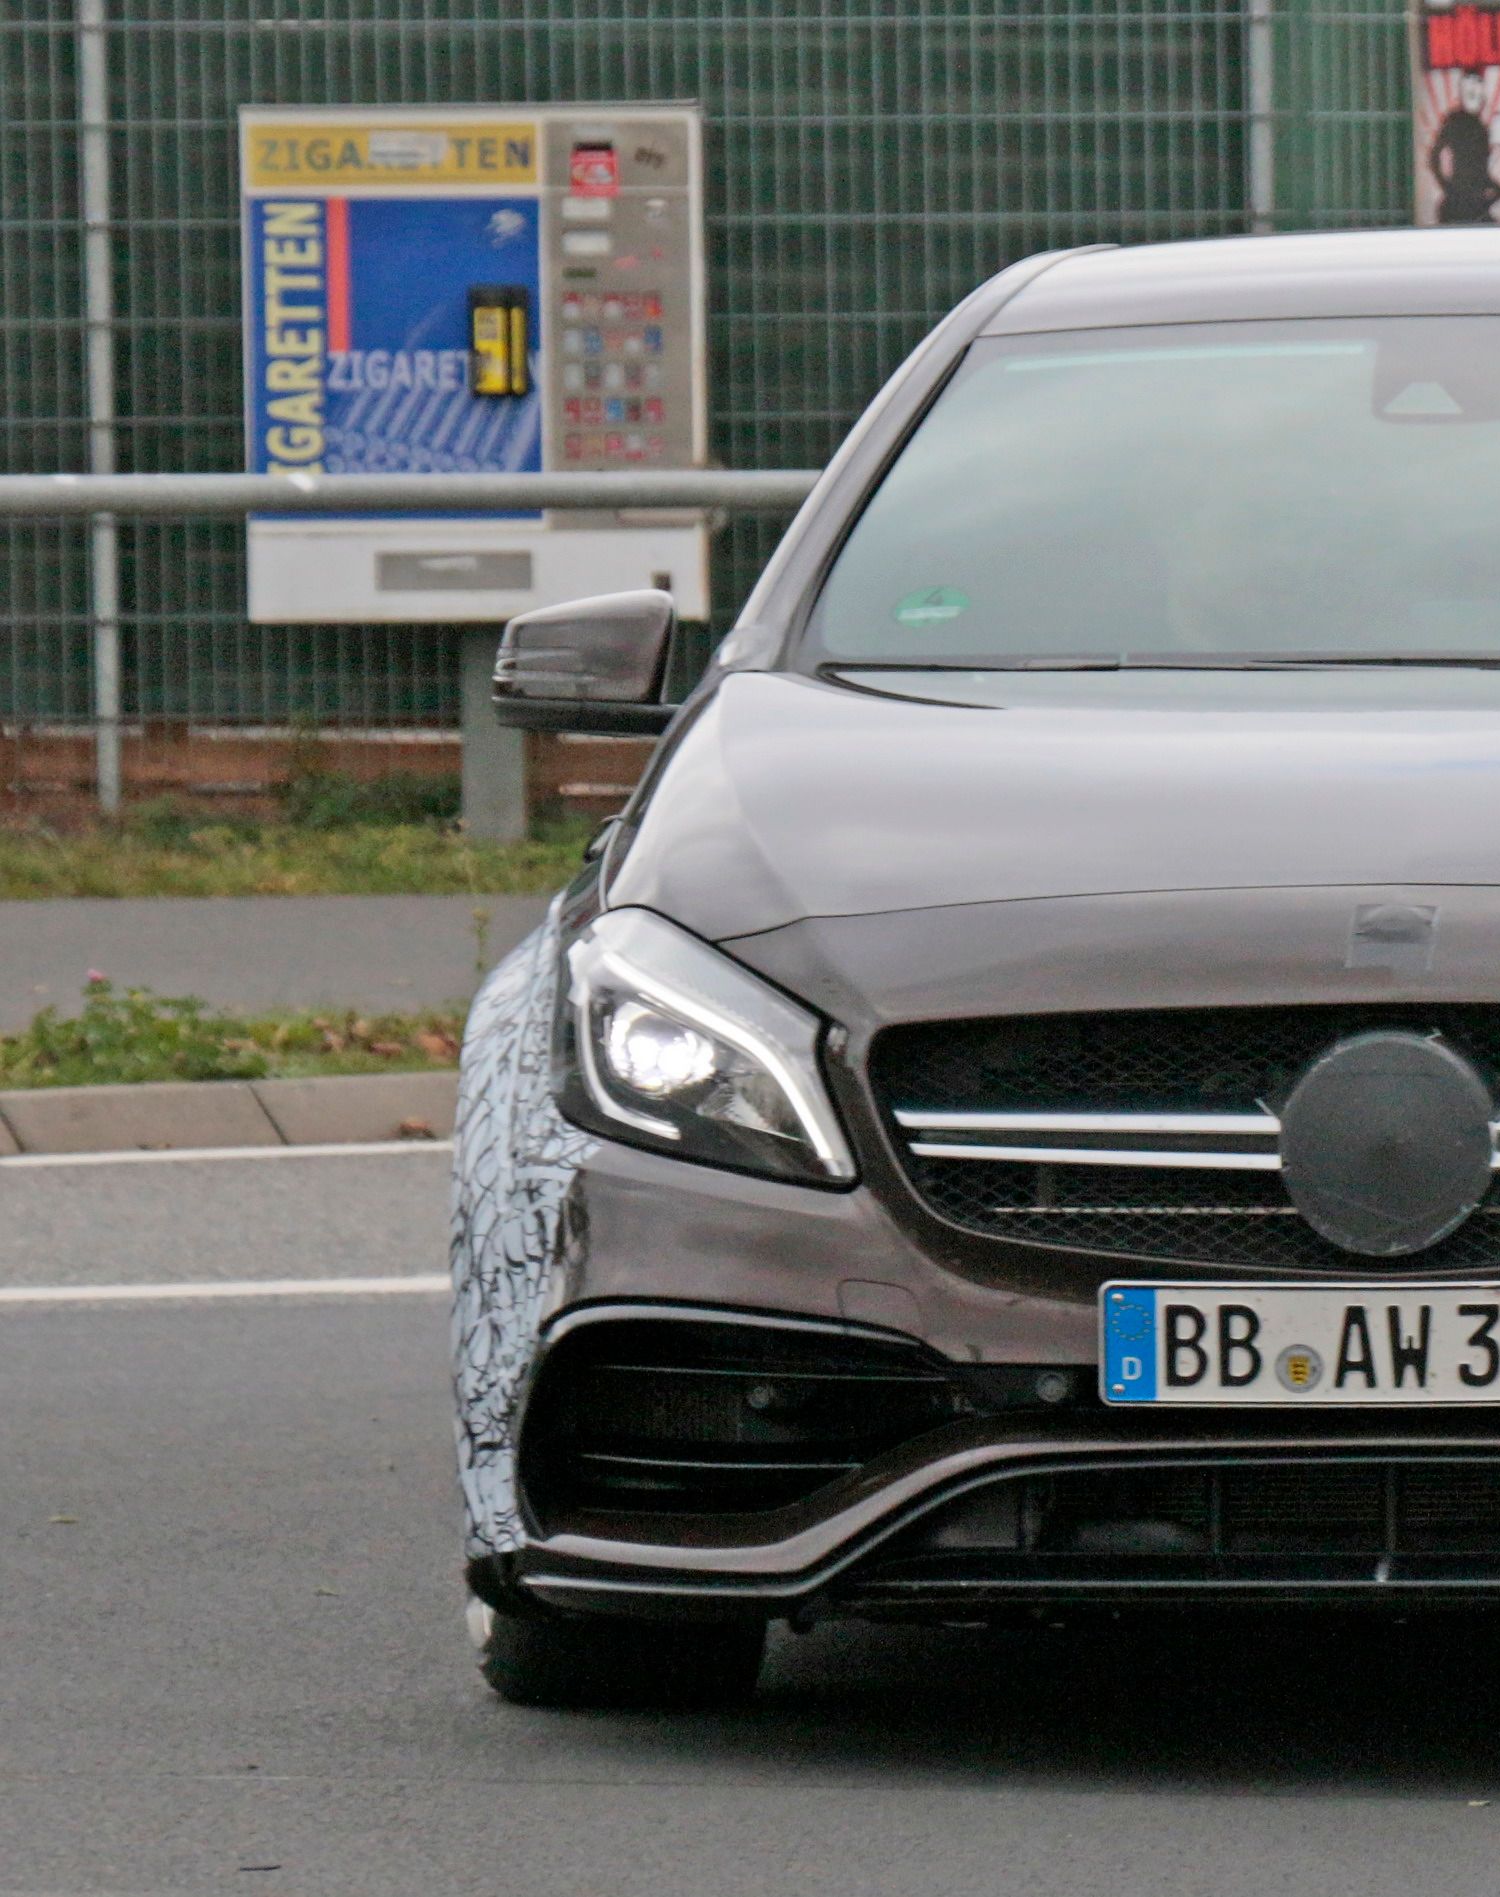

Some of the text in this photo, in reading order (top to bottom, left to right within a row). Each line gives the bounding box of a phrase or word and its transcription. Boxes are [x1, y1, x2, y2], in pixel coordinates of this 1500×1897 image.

[256, 136, 531, 172] ZIGATEN
[265, 202, 324, 475] GARETTEN
[1121, 1355, 1142, 1380] D
[1164, 1304, 1261, 1388] BB
[1334, 1305, 1432, 1390] AW
